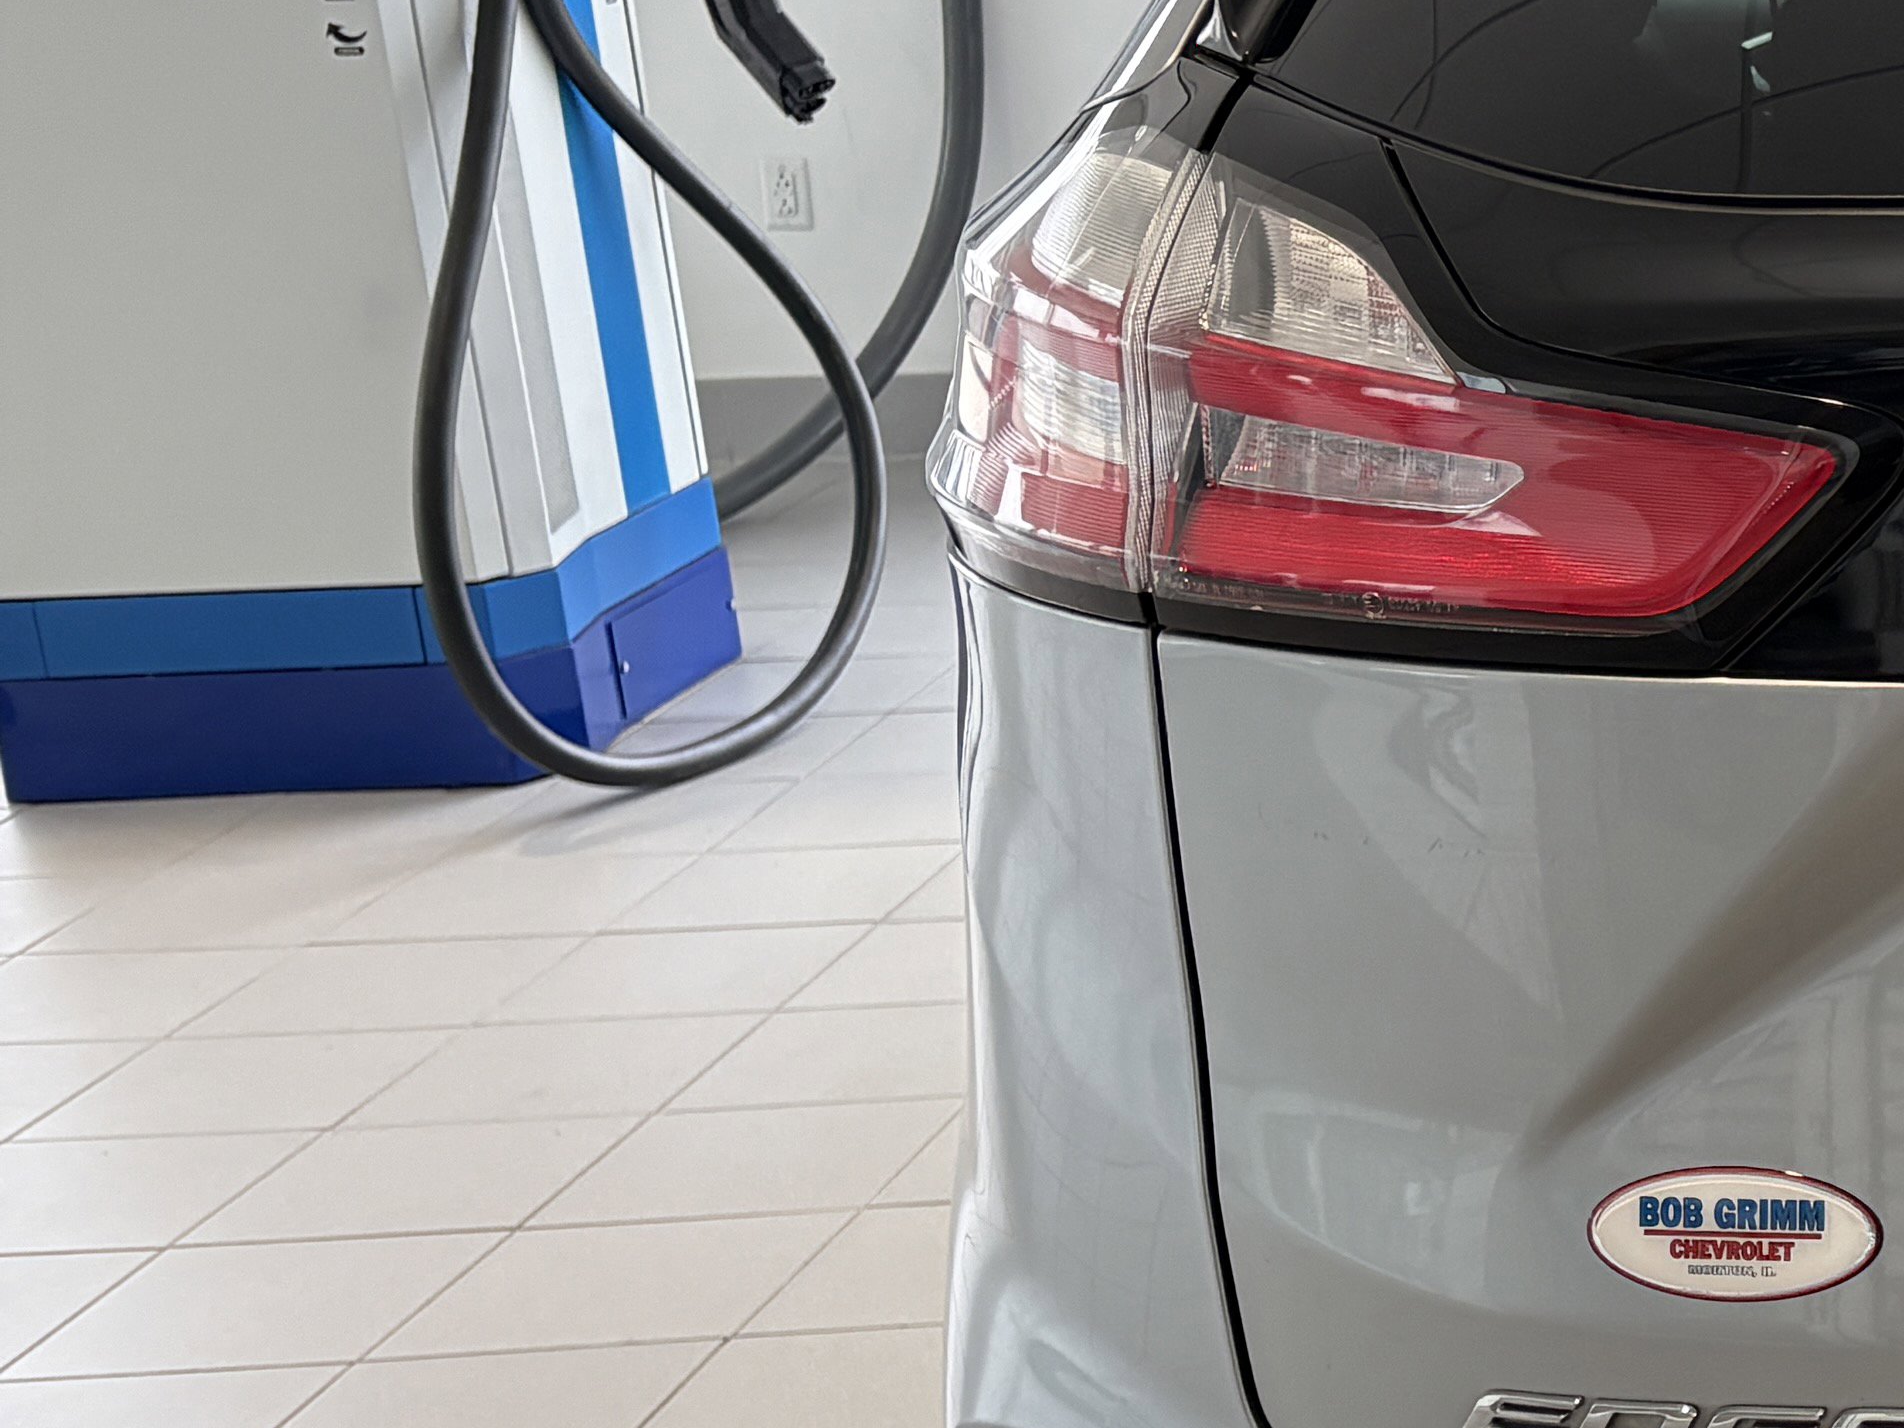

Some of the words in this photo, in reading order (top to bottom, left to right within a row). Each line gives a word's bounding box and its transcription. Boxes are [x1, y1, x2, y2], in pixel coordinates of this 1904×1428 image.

[1638, 1195, 1704, 1229] BOB
[1713, 1197, 1825, 1232] GRIMM
[1669, 1238, 1796, 1262] CHEVROLET
